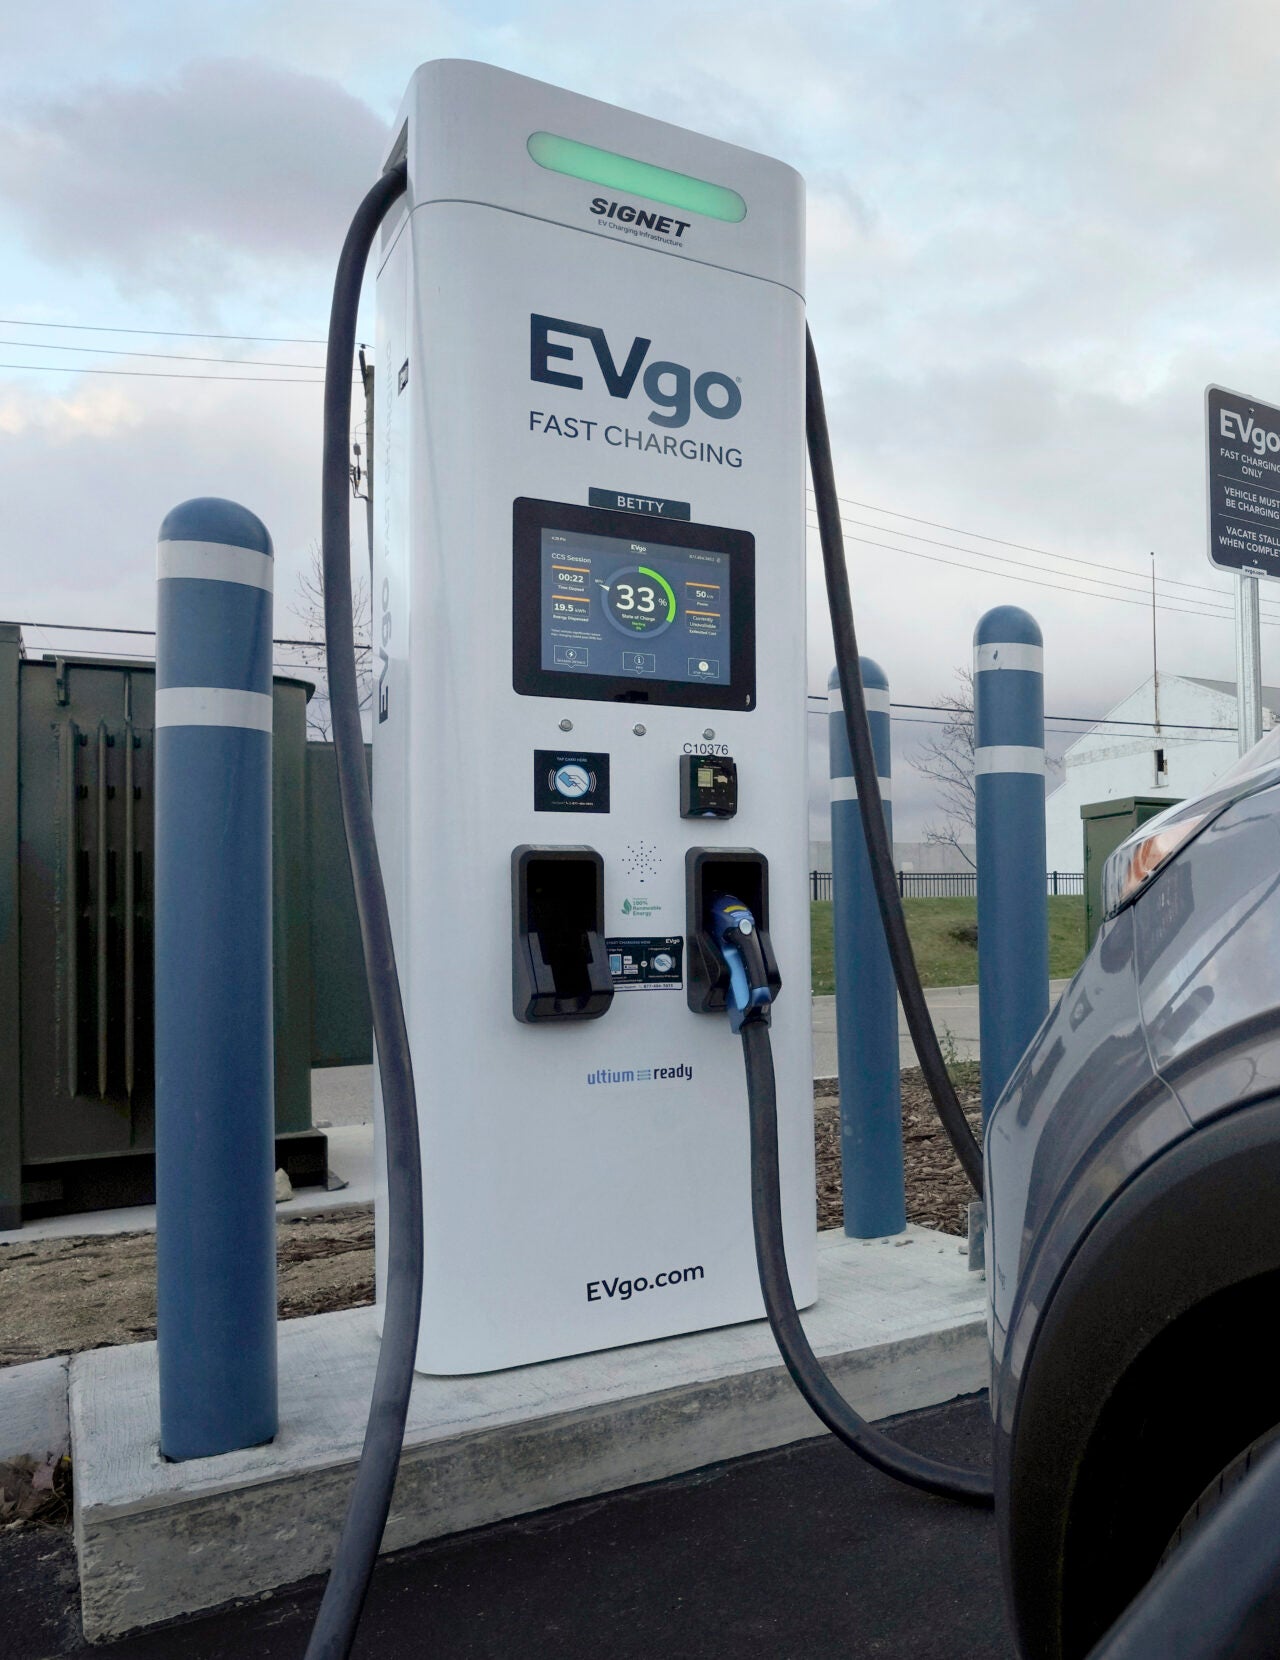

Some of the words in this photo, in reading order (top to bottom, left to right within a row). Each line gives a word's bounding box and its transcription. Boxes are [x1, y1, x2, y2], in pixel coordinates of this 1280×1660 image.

[589, 198, 691, 237] SIGNET
[608, 221, 638, 236] Charging
[639, 231, 683, 247] Infrastructure
[530, 313, 741, 428] EVgo
[529, 411, 597, 441] FAST
[604, 426, 743, 468] CHARGING
[1220, 408, 1280, 455] EVgo
[1220, 448, 1239, 462] FAST
[1241, 465, 1263, 479] ONLY
[617, 495, 664, 513] BETTY
[1224, 486, 1257, 503] VEHICLE
[1259, 495, 1280, 509] MUST
[1225, 498, 1236, 509] BE
[1238, 501, 1280, 520] CHARGING
[1219, 535, 1245, 551] WHEN
[1226, 525, 1257, 541] VACATE
[1258, 533, 1280, 547] STALL
[551, 552, 566, 561] CCS
[566, 554, 592, 564] Session
[558, 573, 584, 583] 00:22
[696, 590, 706, 598] 50
[554, 603, 574, 612] 19.5
[378, 577, 392, 725] EVgo
[683, 742, 729, 756] C10376
[587, 1068, 634, 1085] ultium
[653, 1063, 693, 1081] ready
[586, 1264, 705, 1302] EVgo.com
